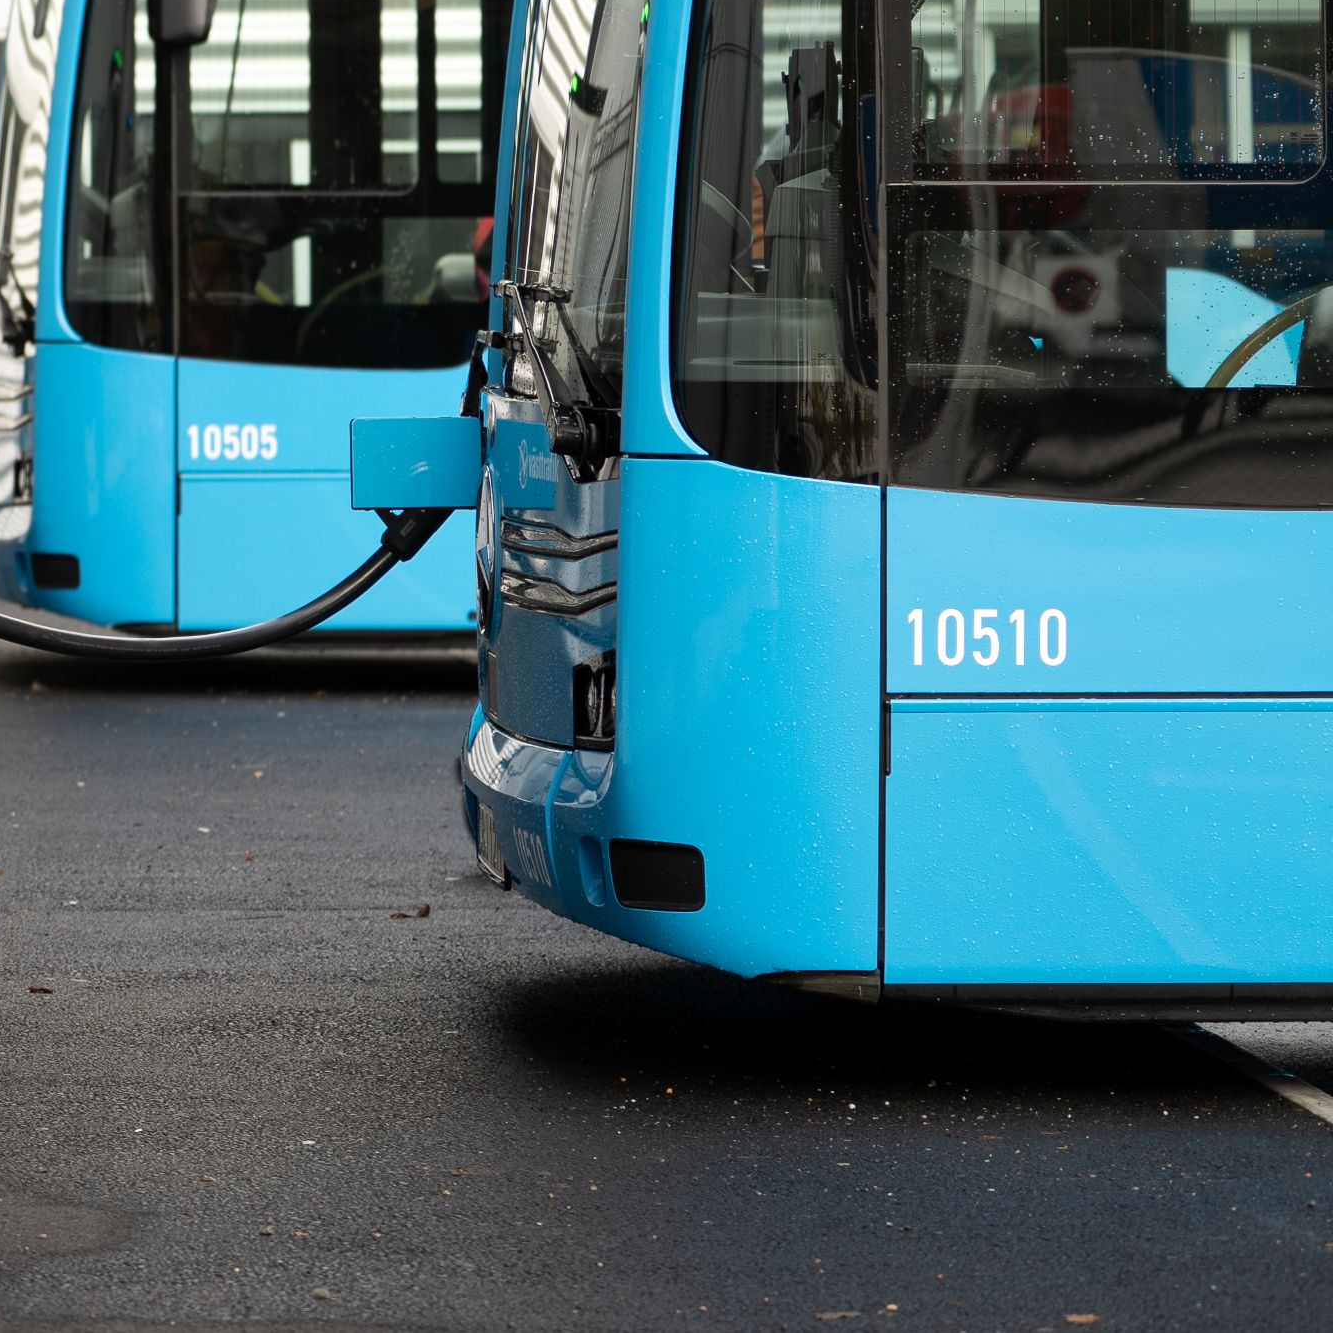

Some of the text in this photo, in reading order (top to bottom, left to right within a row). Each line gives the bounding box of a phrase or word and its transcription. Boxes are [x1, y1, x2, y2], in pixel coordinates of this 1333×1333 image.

[188, 425, 278, 460] 10505
[907, 608, 1068, 667] 10510
[513, 825, 552, 888] 10510
